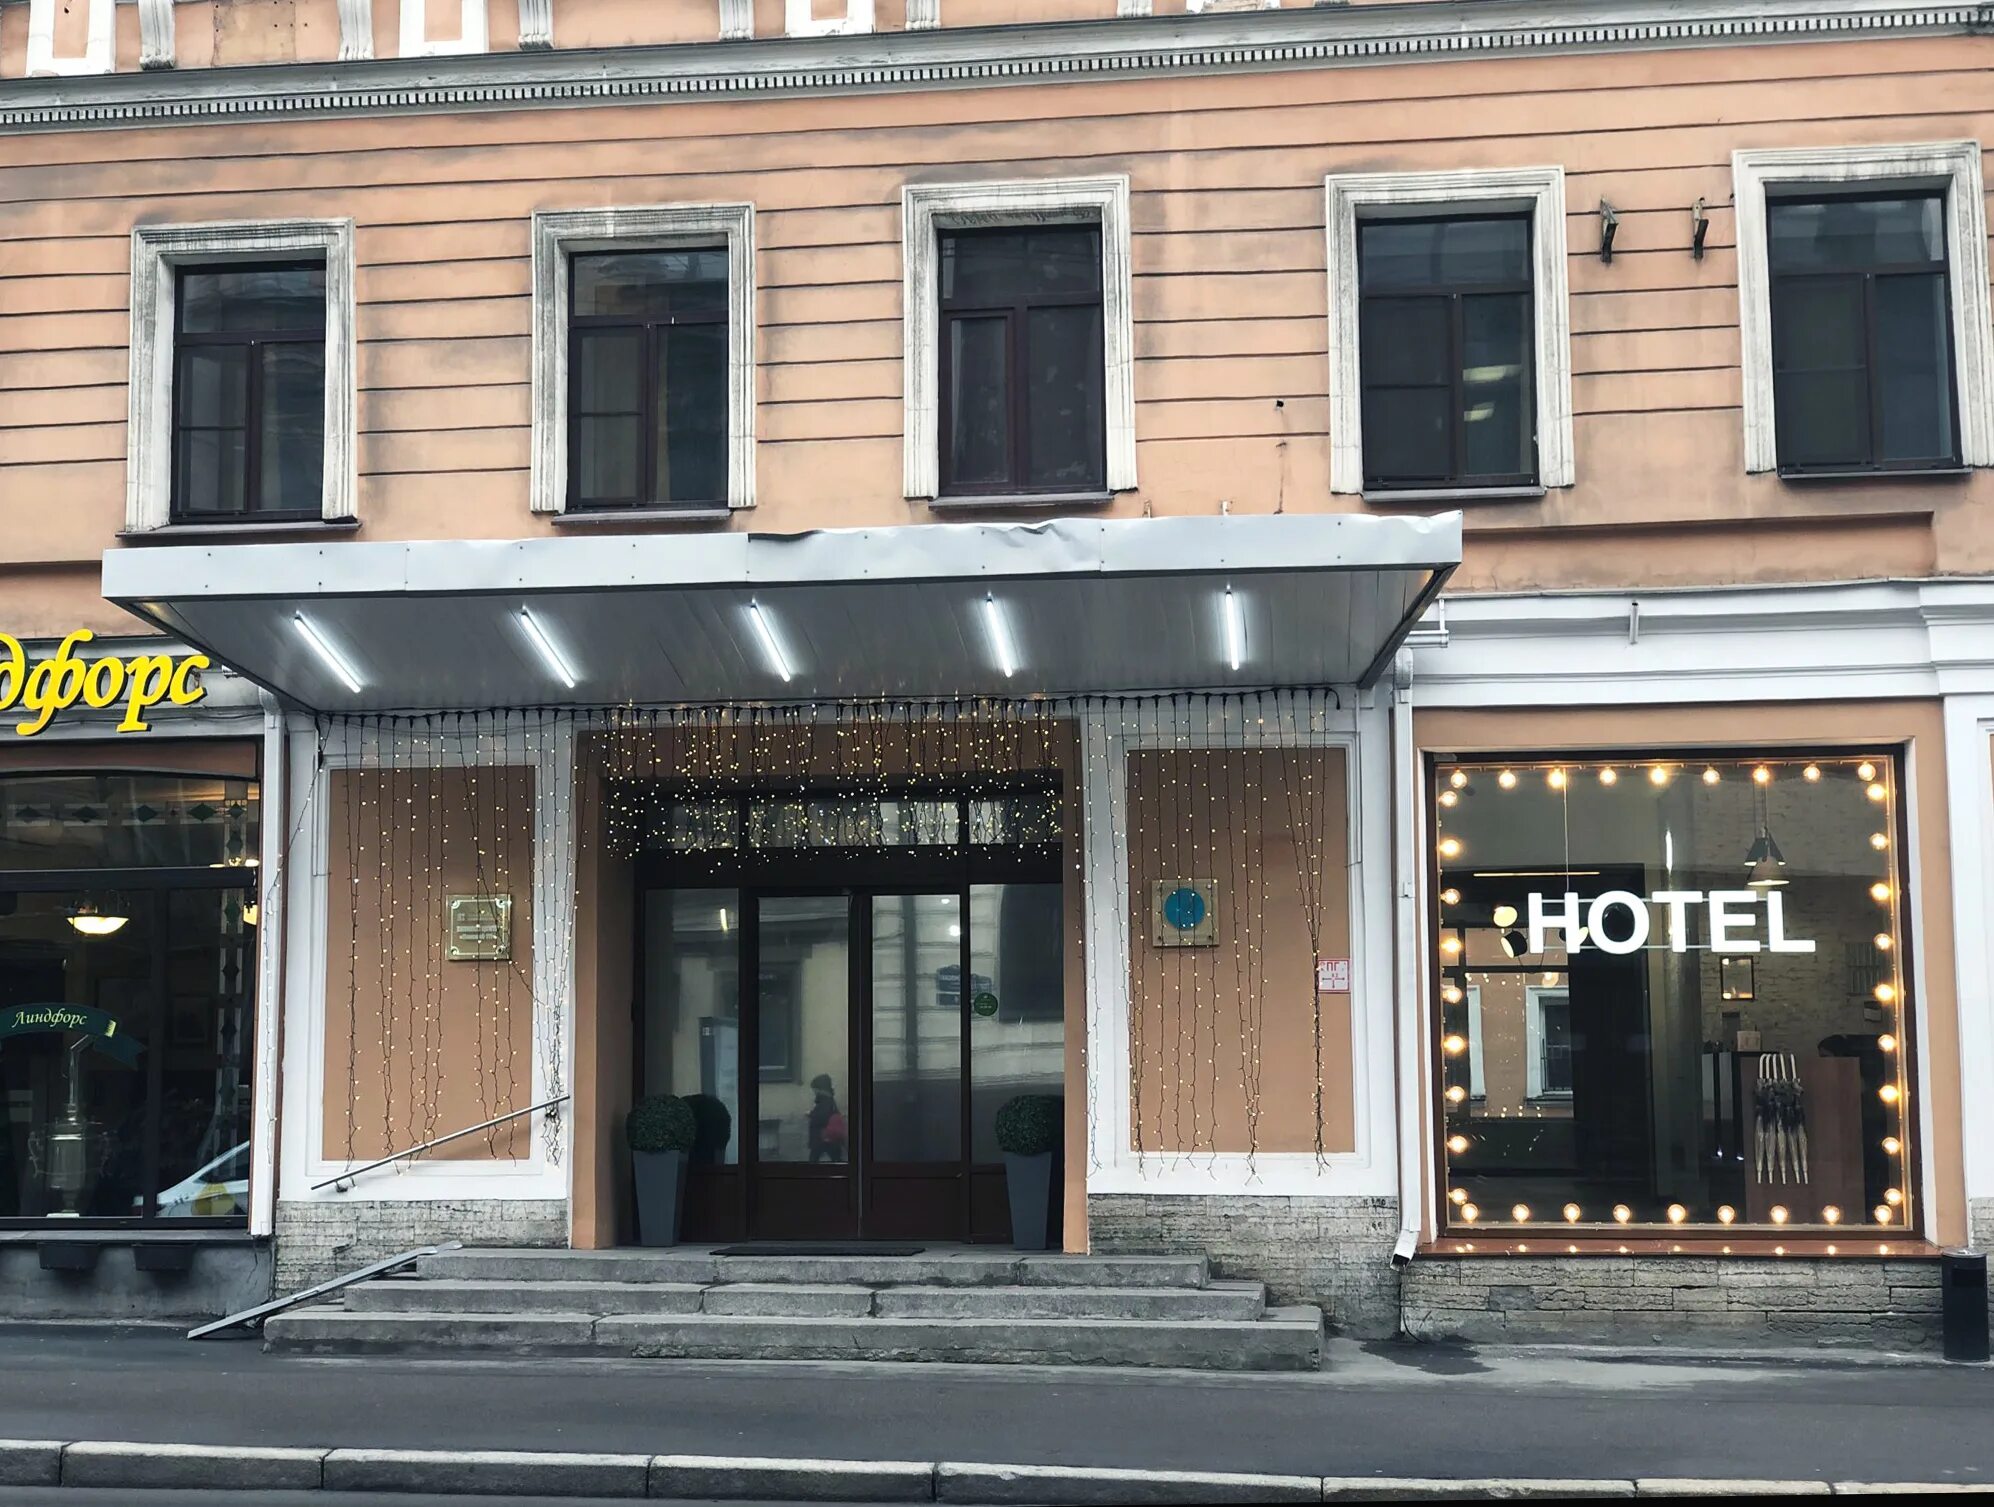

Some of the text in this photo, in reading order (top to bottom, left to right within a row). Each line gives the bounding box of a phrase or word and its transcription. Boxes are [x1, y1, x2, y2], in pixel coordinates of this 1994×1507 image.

[0, 629, 210, 736] дфорс
[1528, 890, 1816, 955] HOTEL
[11, 1008, 88, 1028] Линдфорс
